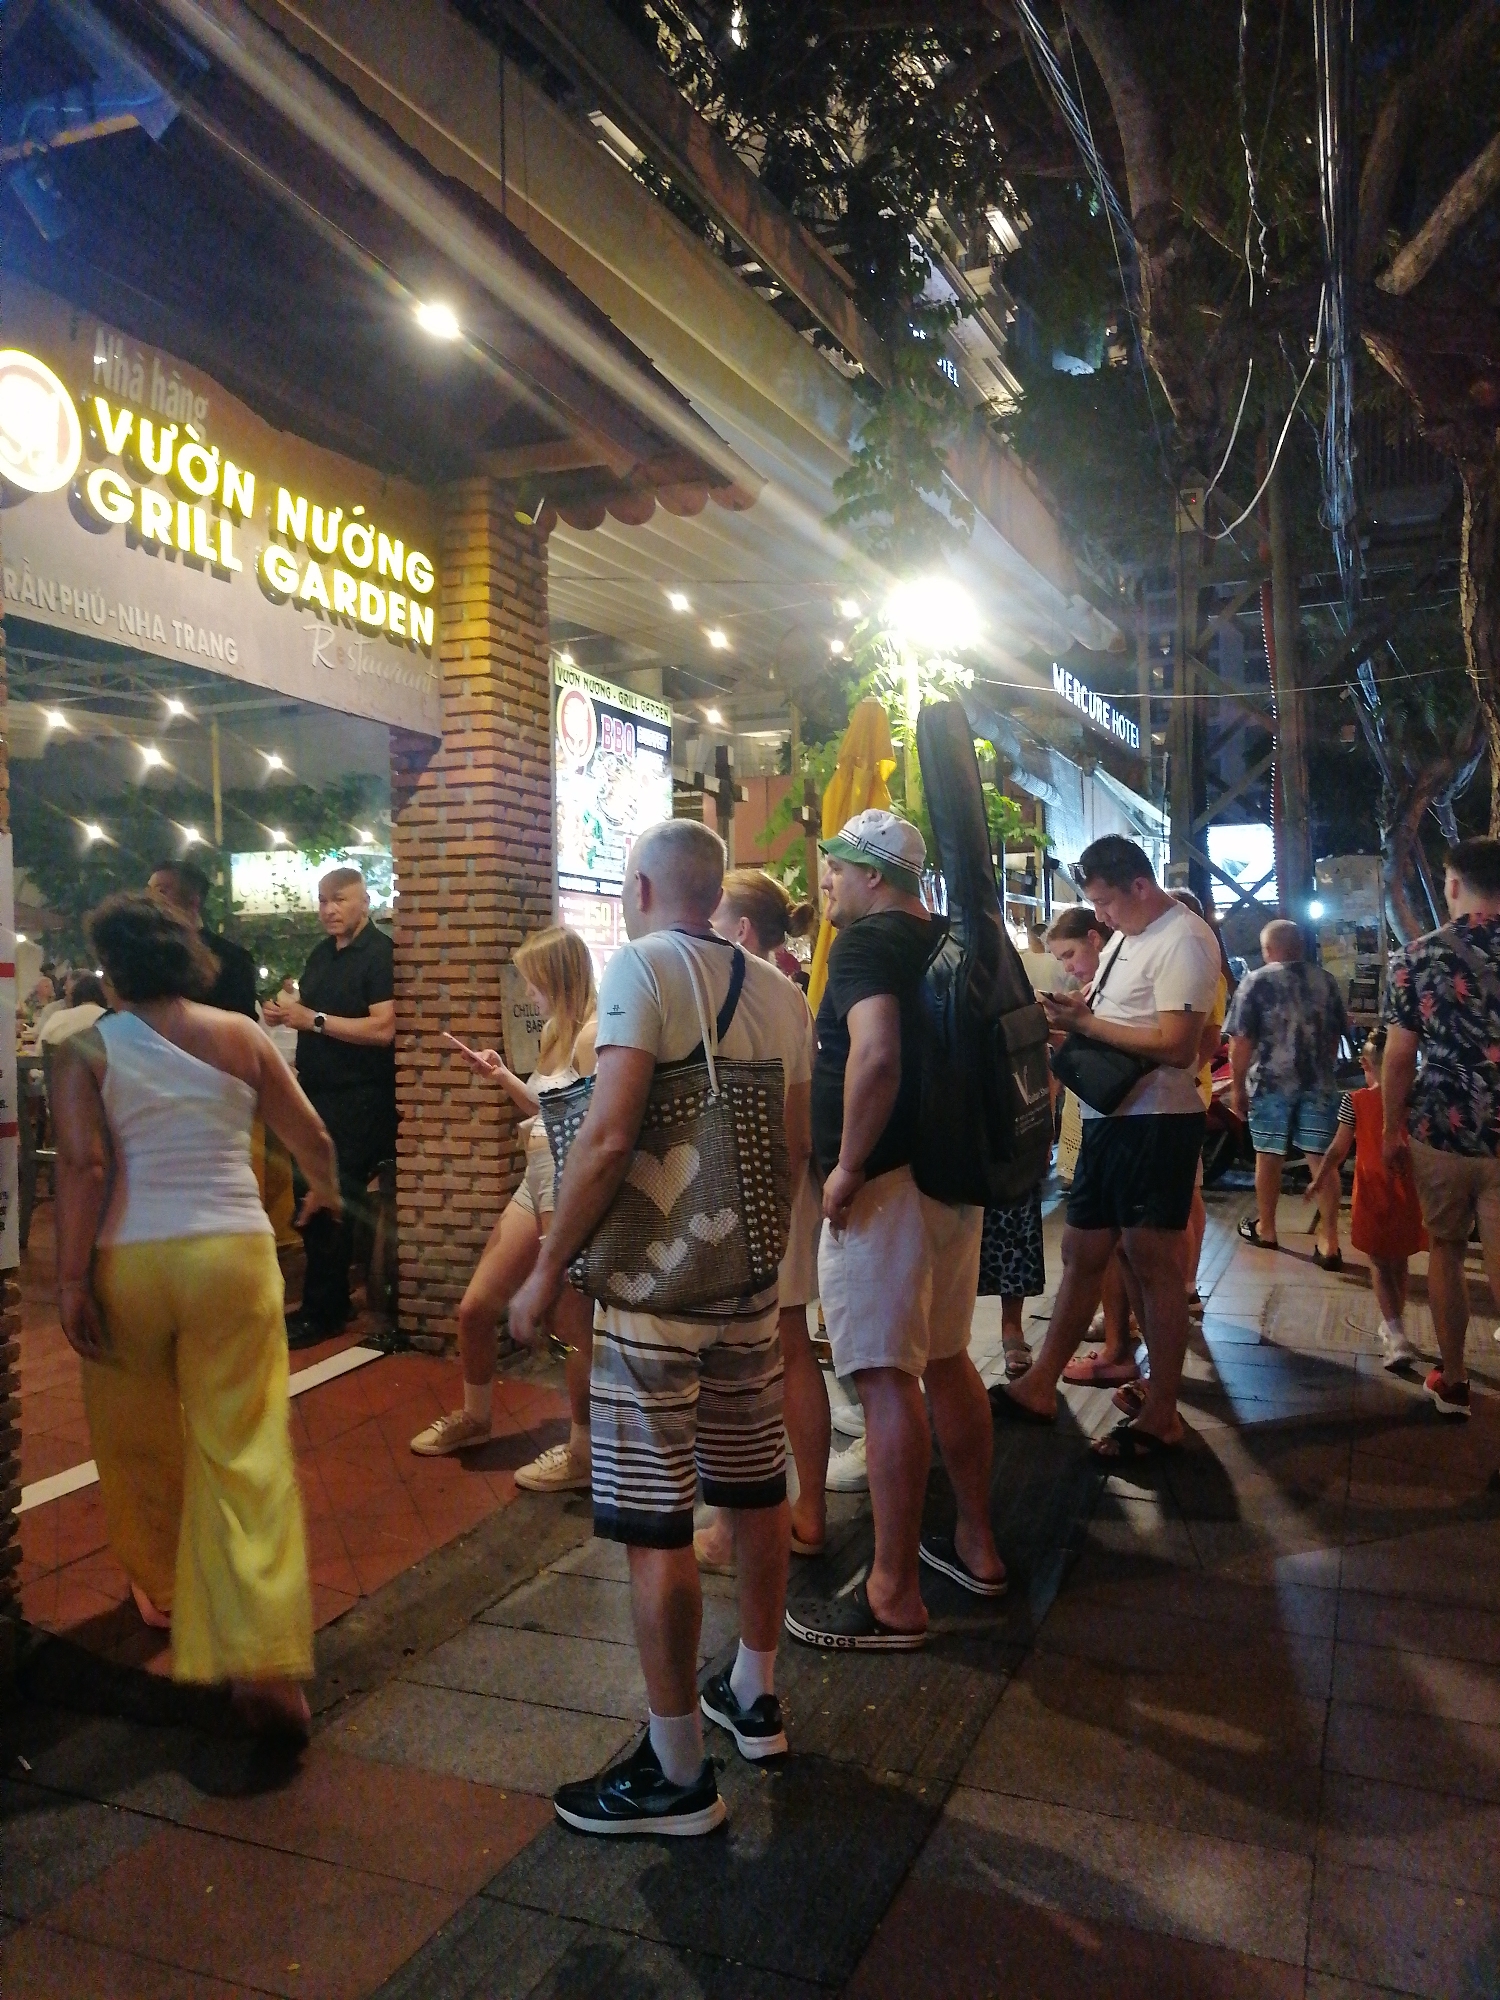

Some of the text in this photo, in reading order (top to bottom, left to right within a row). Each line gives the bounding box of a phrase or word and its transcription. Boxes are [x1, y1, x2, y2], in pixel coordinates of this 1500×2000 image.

[94, 396, 435, 594] VƯỜN NƯỚNG
[87, 468, 434, 646] GRILL GARDEN
[171, 620, 239, 666] TRANG
[618, 691, 638, 710] GRILL
[640, 700, 669, 722] GARDEN
[1053, 663, 1110, 730] MERCURE
[602, 714, 635, 758] BBQ
[805, 1631, 856, 1648] crocs
